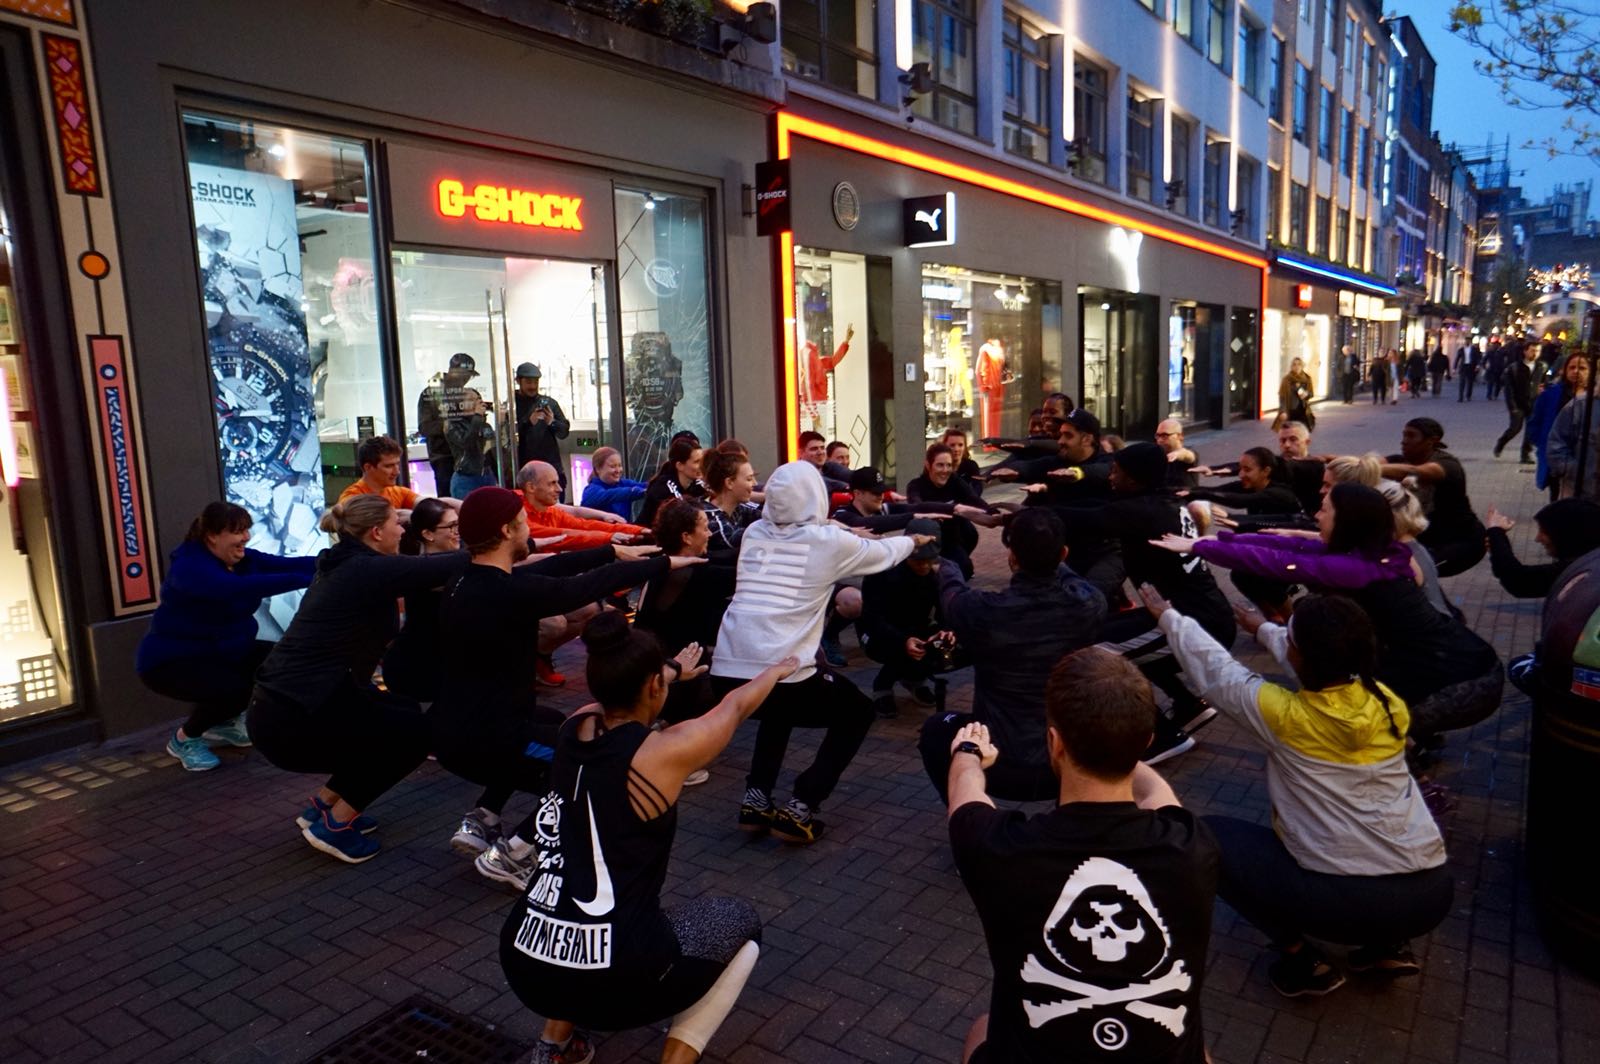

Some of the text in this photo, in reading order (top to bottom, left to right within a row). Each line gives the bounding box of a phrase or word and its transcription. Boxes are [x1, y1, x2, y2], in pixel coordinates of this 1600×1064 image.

[438, 179, 583, 231] G-SHOCK
[757, 190, 787, 200] G-SHOCK
[243, 344, 289, 382] G-SHOCK
